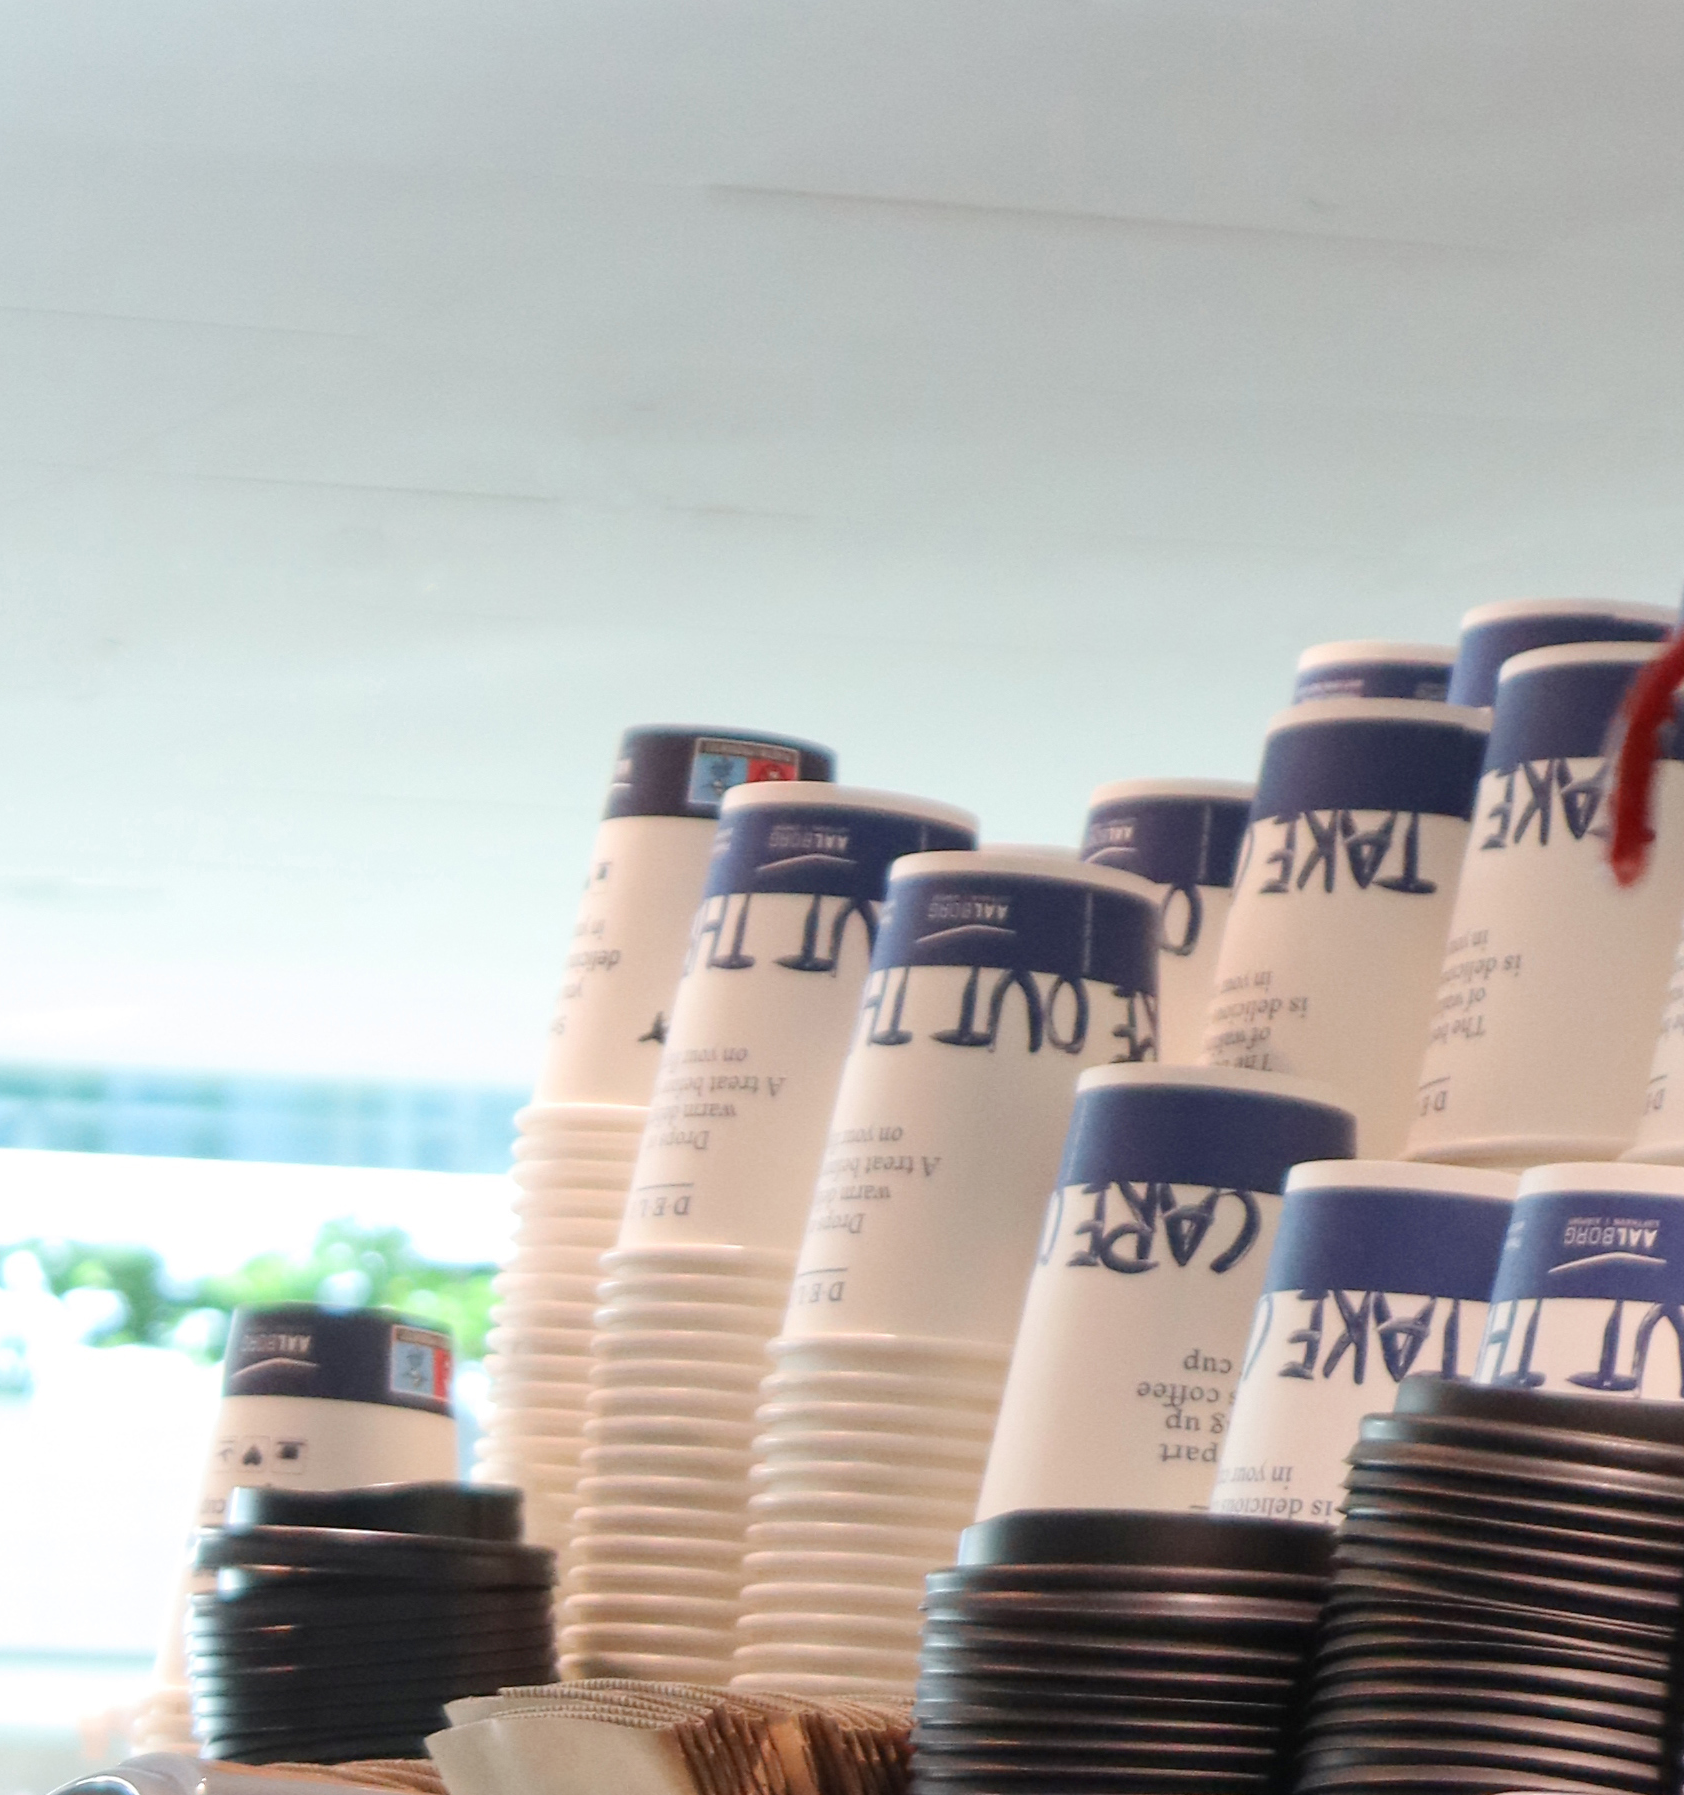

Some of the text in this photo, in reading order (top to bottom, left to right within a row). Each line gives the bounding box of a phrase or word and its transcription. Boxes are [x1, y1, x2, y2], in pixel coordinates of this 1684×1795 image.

[1482, 758, 1611, 851] AKE
[1259, 809, 1437, 894] TAKE
[930, 966, 1089, 1055] OUT
[921, 1156, 941, 1177] A
[1066, 1180, 1261, 1275] CARE
[1564, 1226, 1657, 1249] AALBORG
[1182, 1349, 1232, 1378] cup
[1136, 1381, 1220, 1408] coffee
[1164, 1410, 1200, 1433] up
[1159, 1442, 1218, 1464] part
[1272, 1466, 1293, 1490] in
[1312, 1499, 1334, 1518] is
